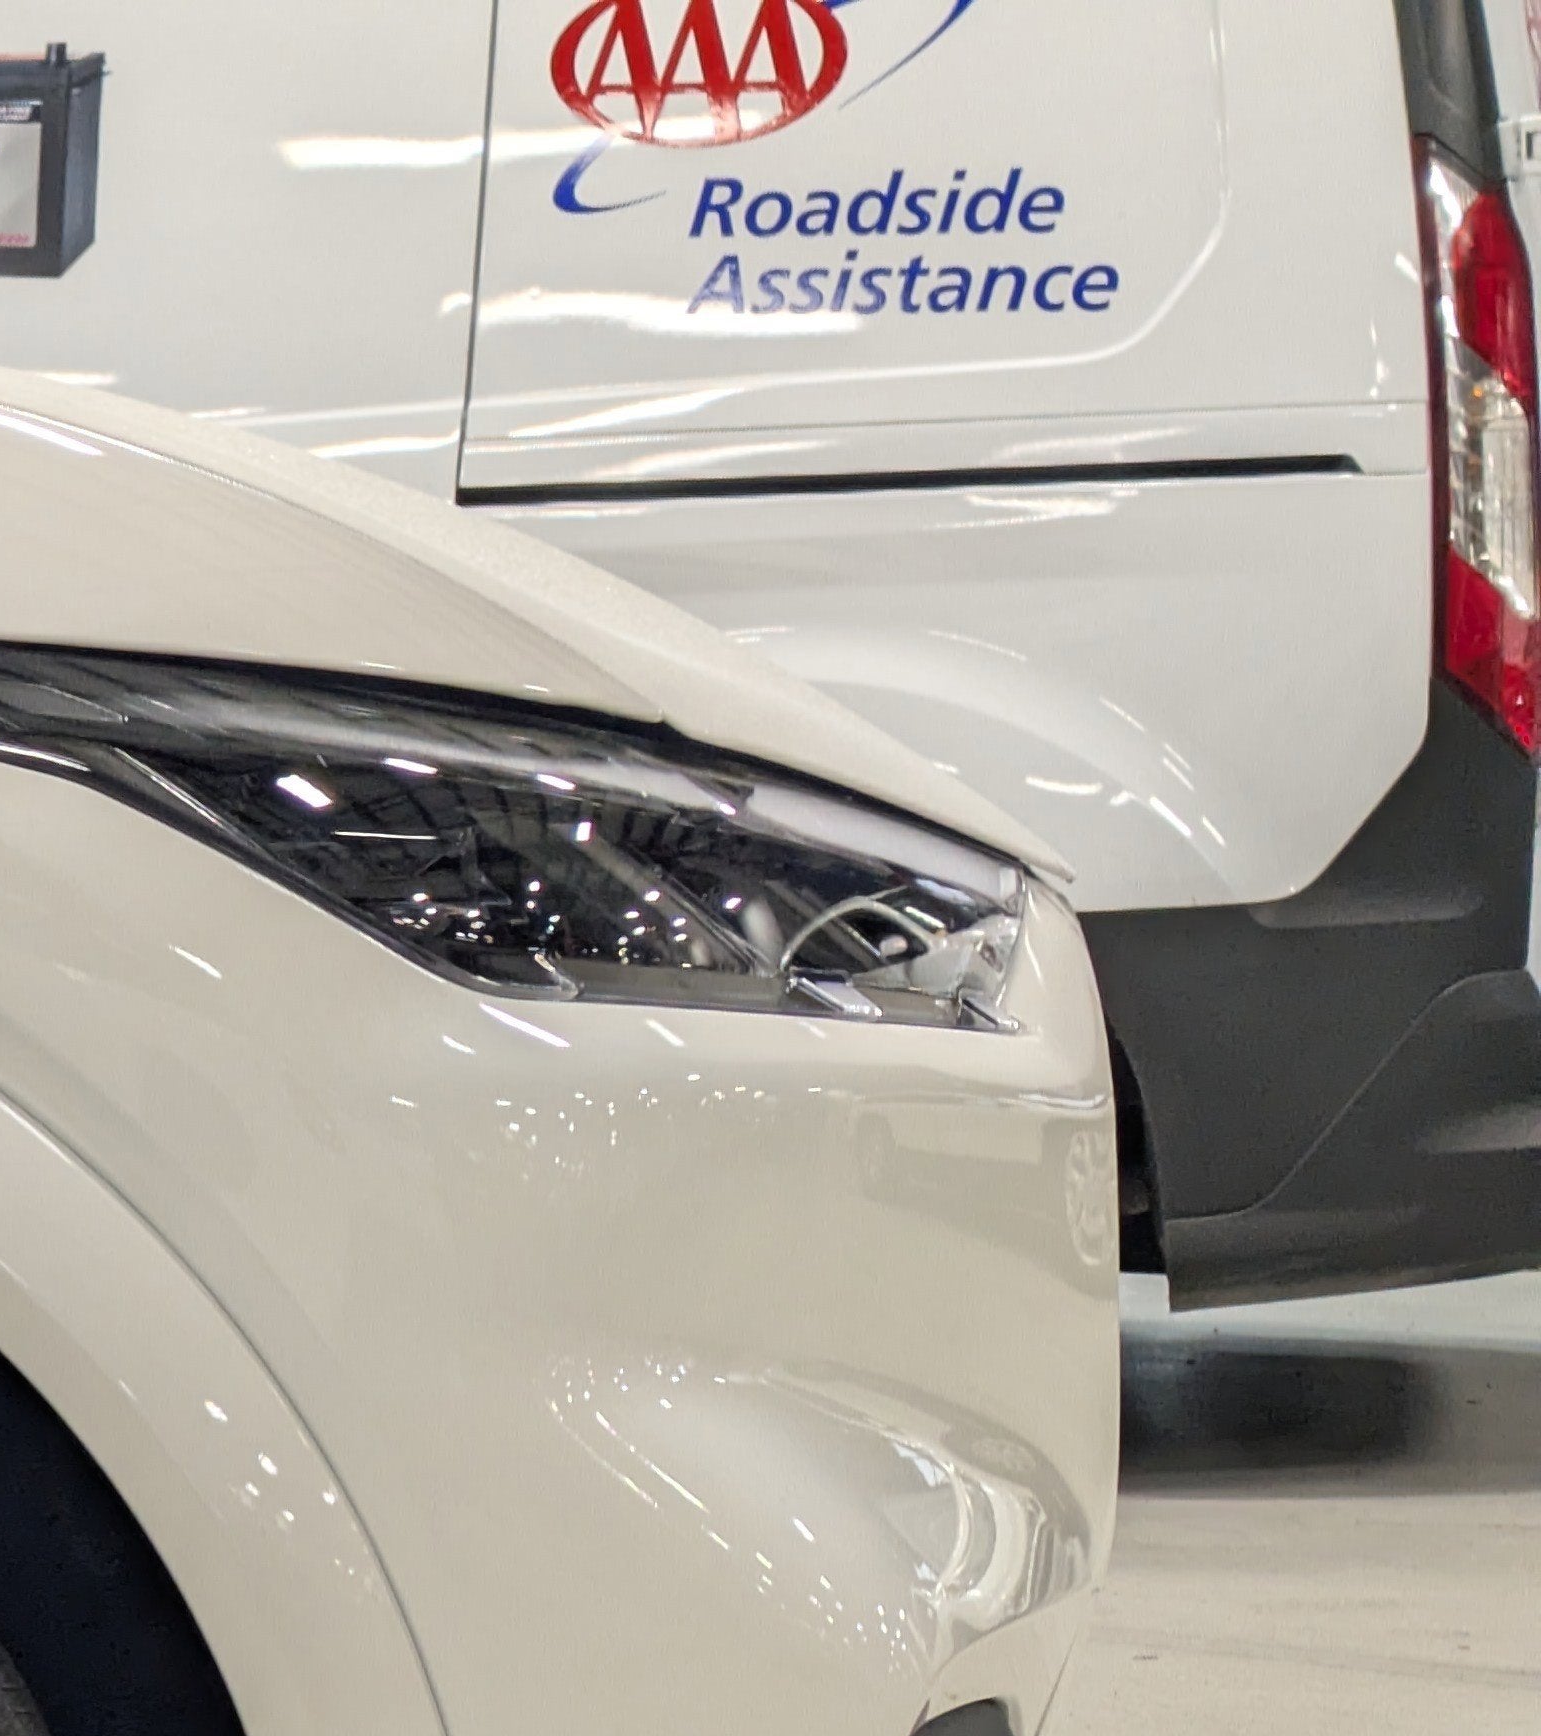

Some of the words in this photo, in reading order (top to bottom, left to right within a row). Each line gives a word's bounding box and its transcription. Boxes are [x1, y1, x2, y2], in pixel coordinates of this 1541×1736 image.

[562, 0, 832, 145] AAA
[688, 168, 1064, 238] Roadside
[686, 250, 1120, 315] Assistance
